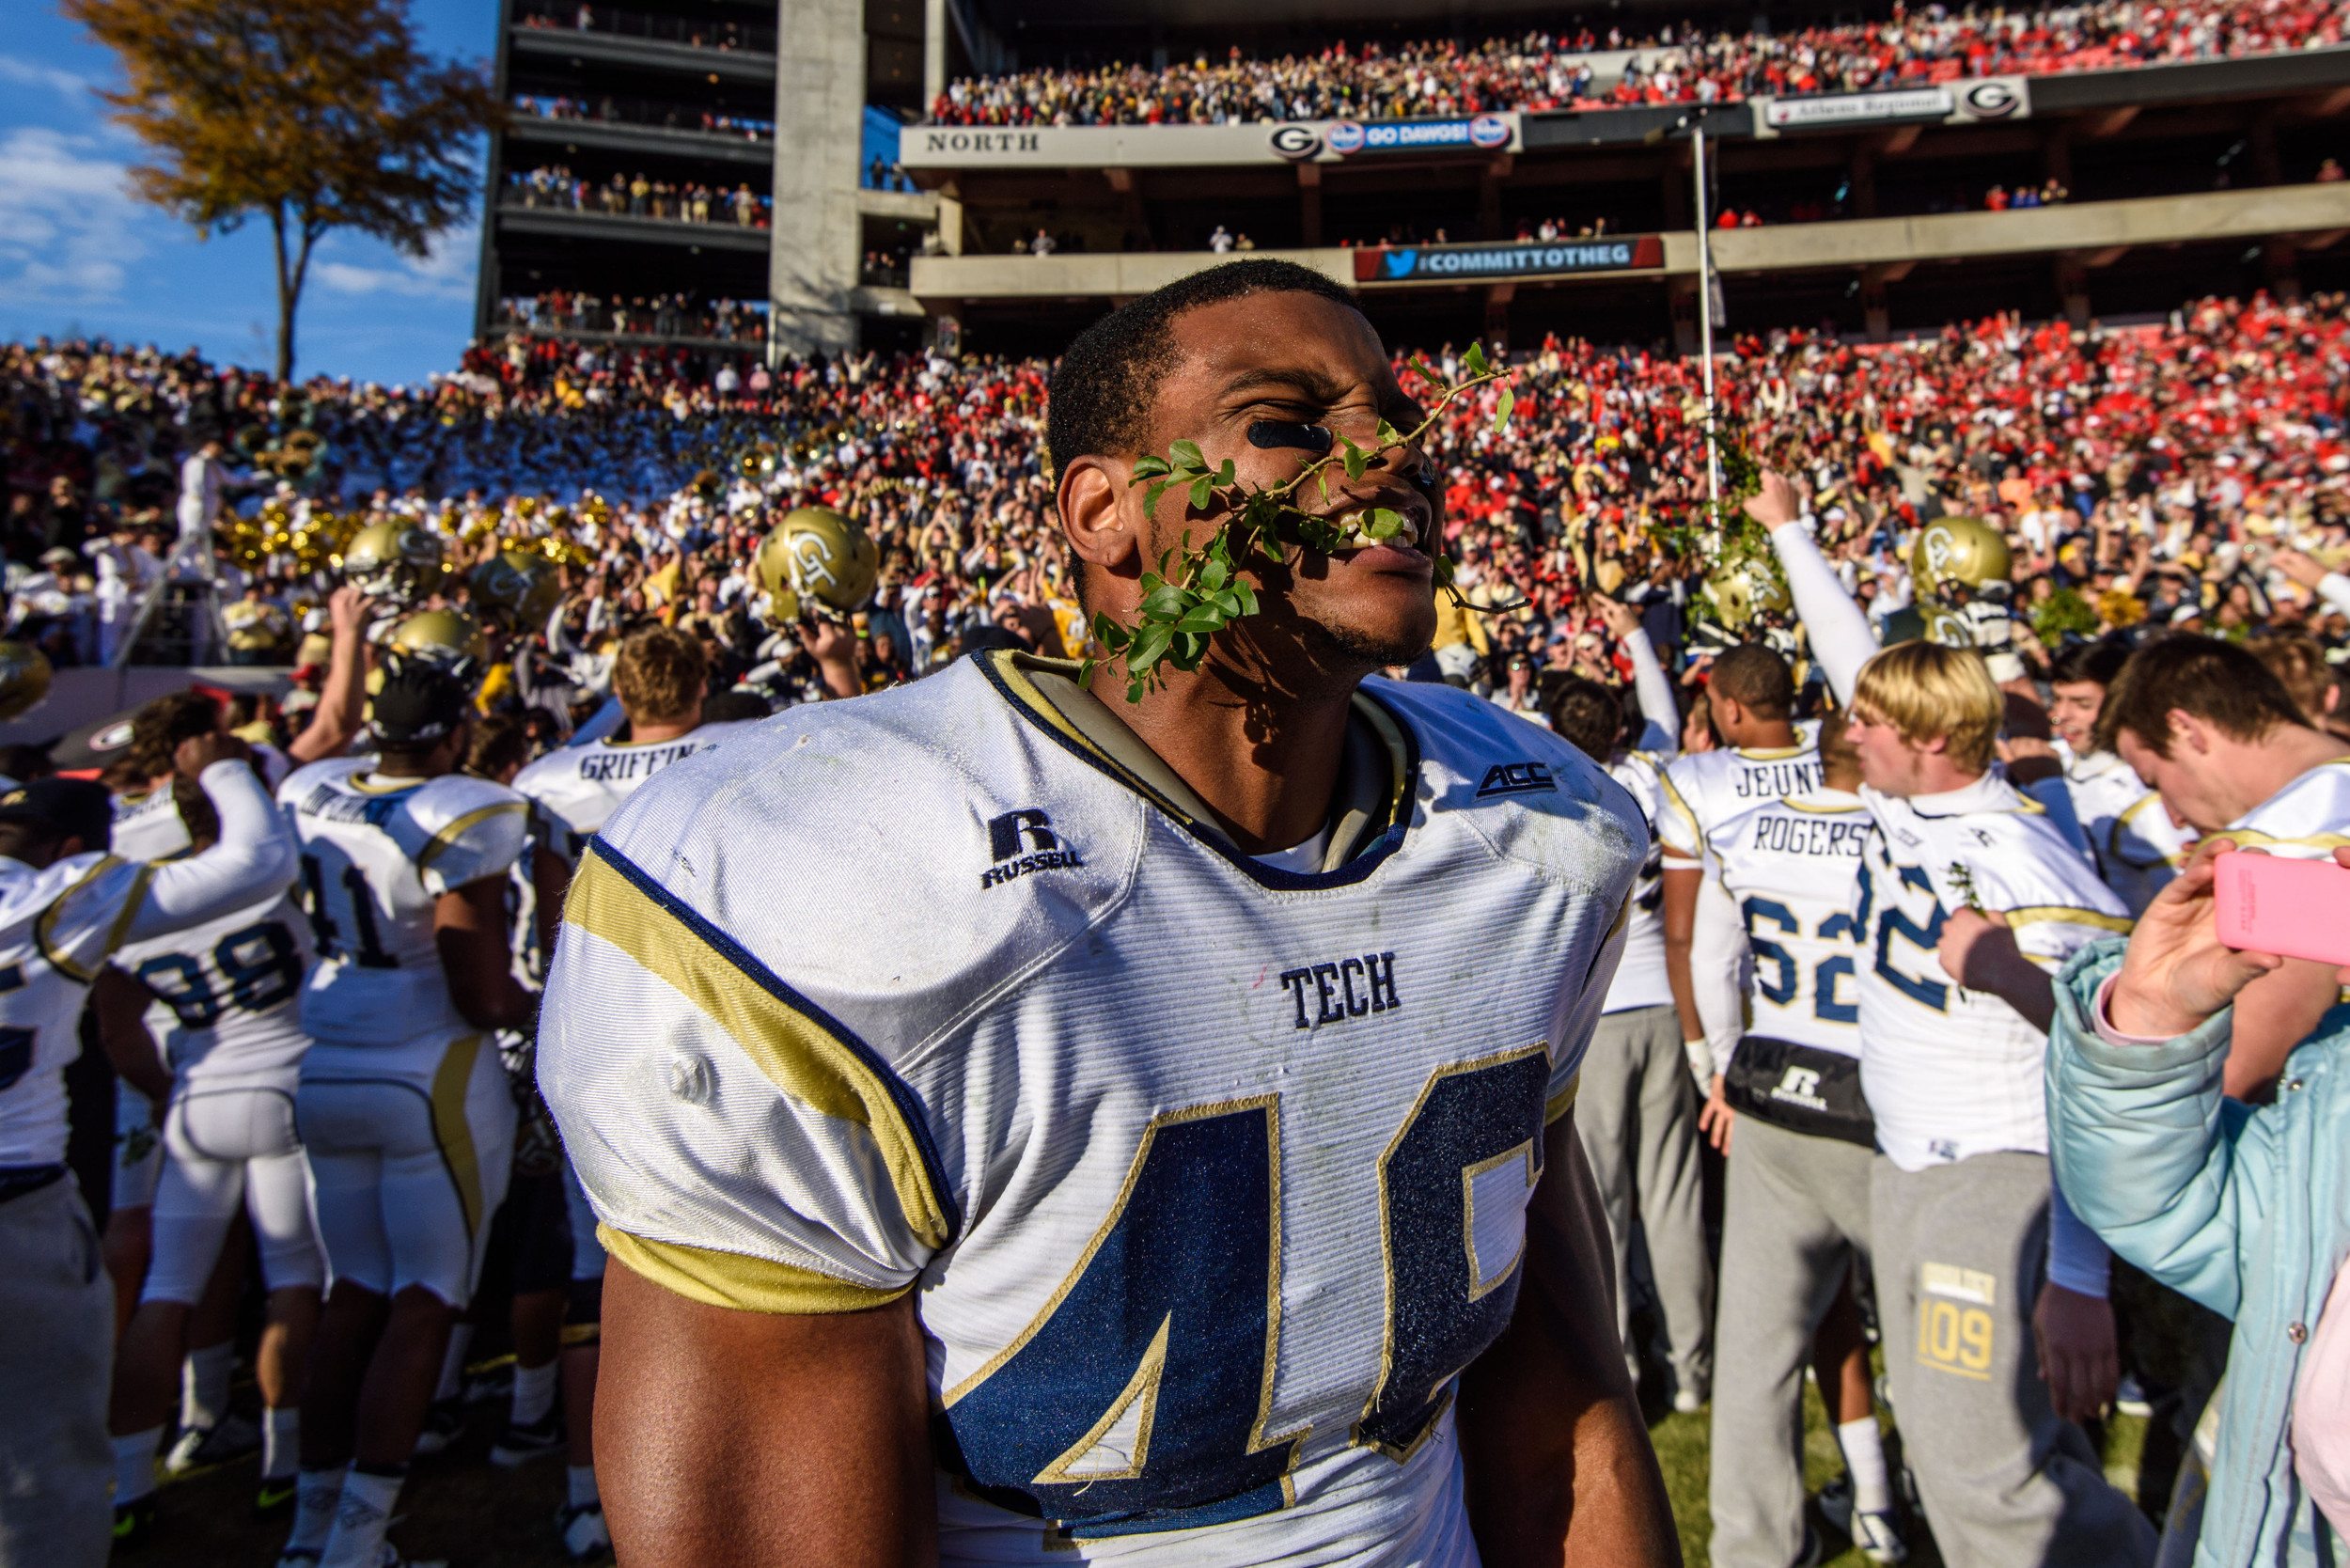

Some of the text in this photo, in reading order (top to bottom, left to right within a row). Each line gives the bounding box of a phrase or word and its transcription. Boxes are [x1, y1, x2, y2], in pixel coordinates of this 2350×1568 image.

[928, 133, 1039, 151] NORTH
[1368, 127, 1397, 145] GO
[1418, 244, 1630, 272] #COMMITTOTHEG
[1480, 761, 1553, 790] ACC
[1754, 816, 1870, 856] ROGERS
[980, 851, 1084, 890] RUSSELL
[1279, 951, 1402, 1029] TECH
